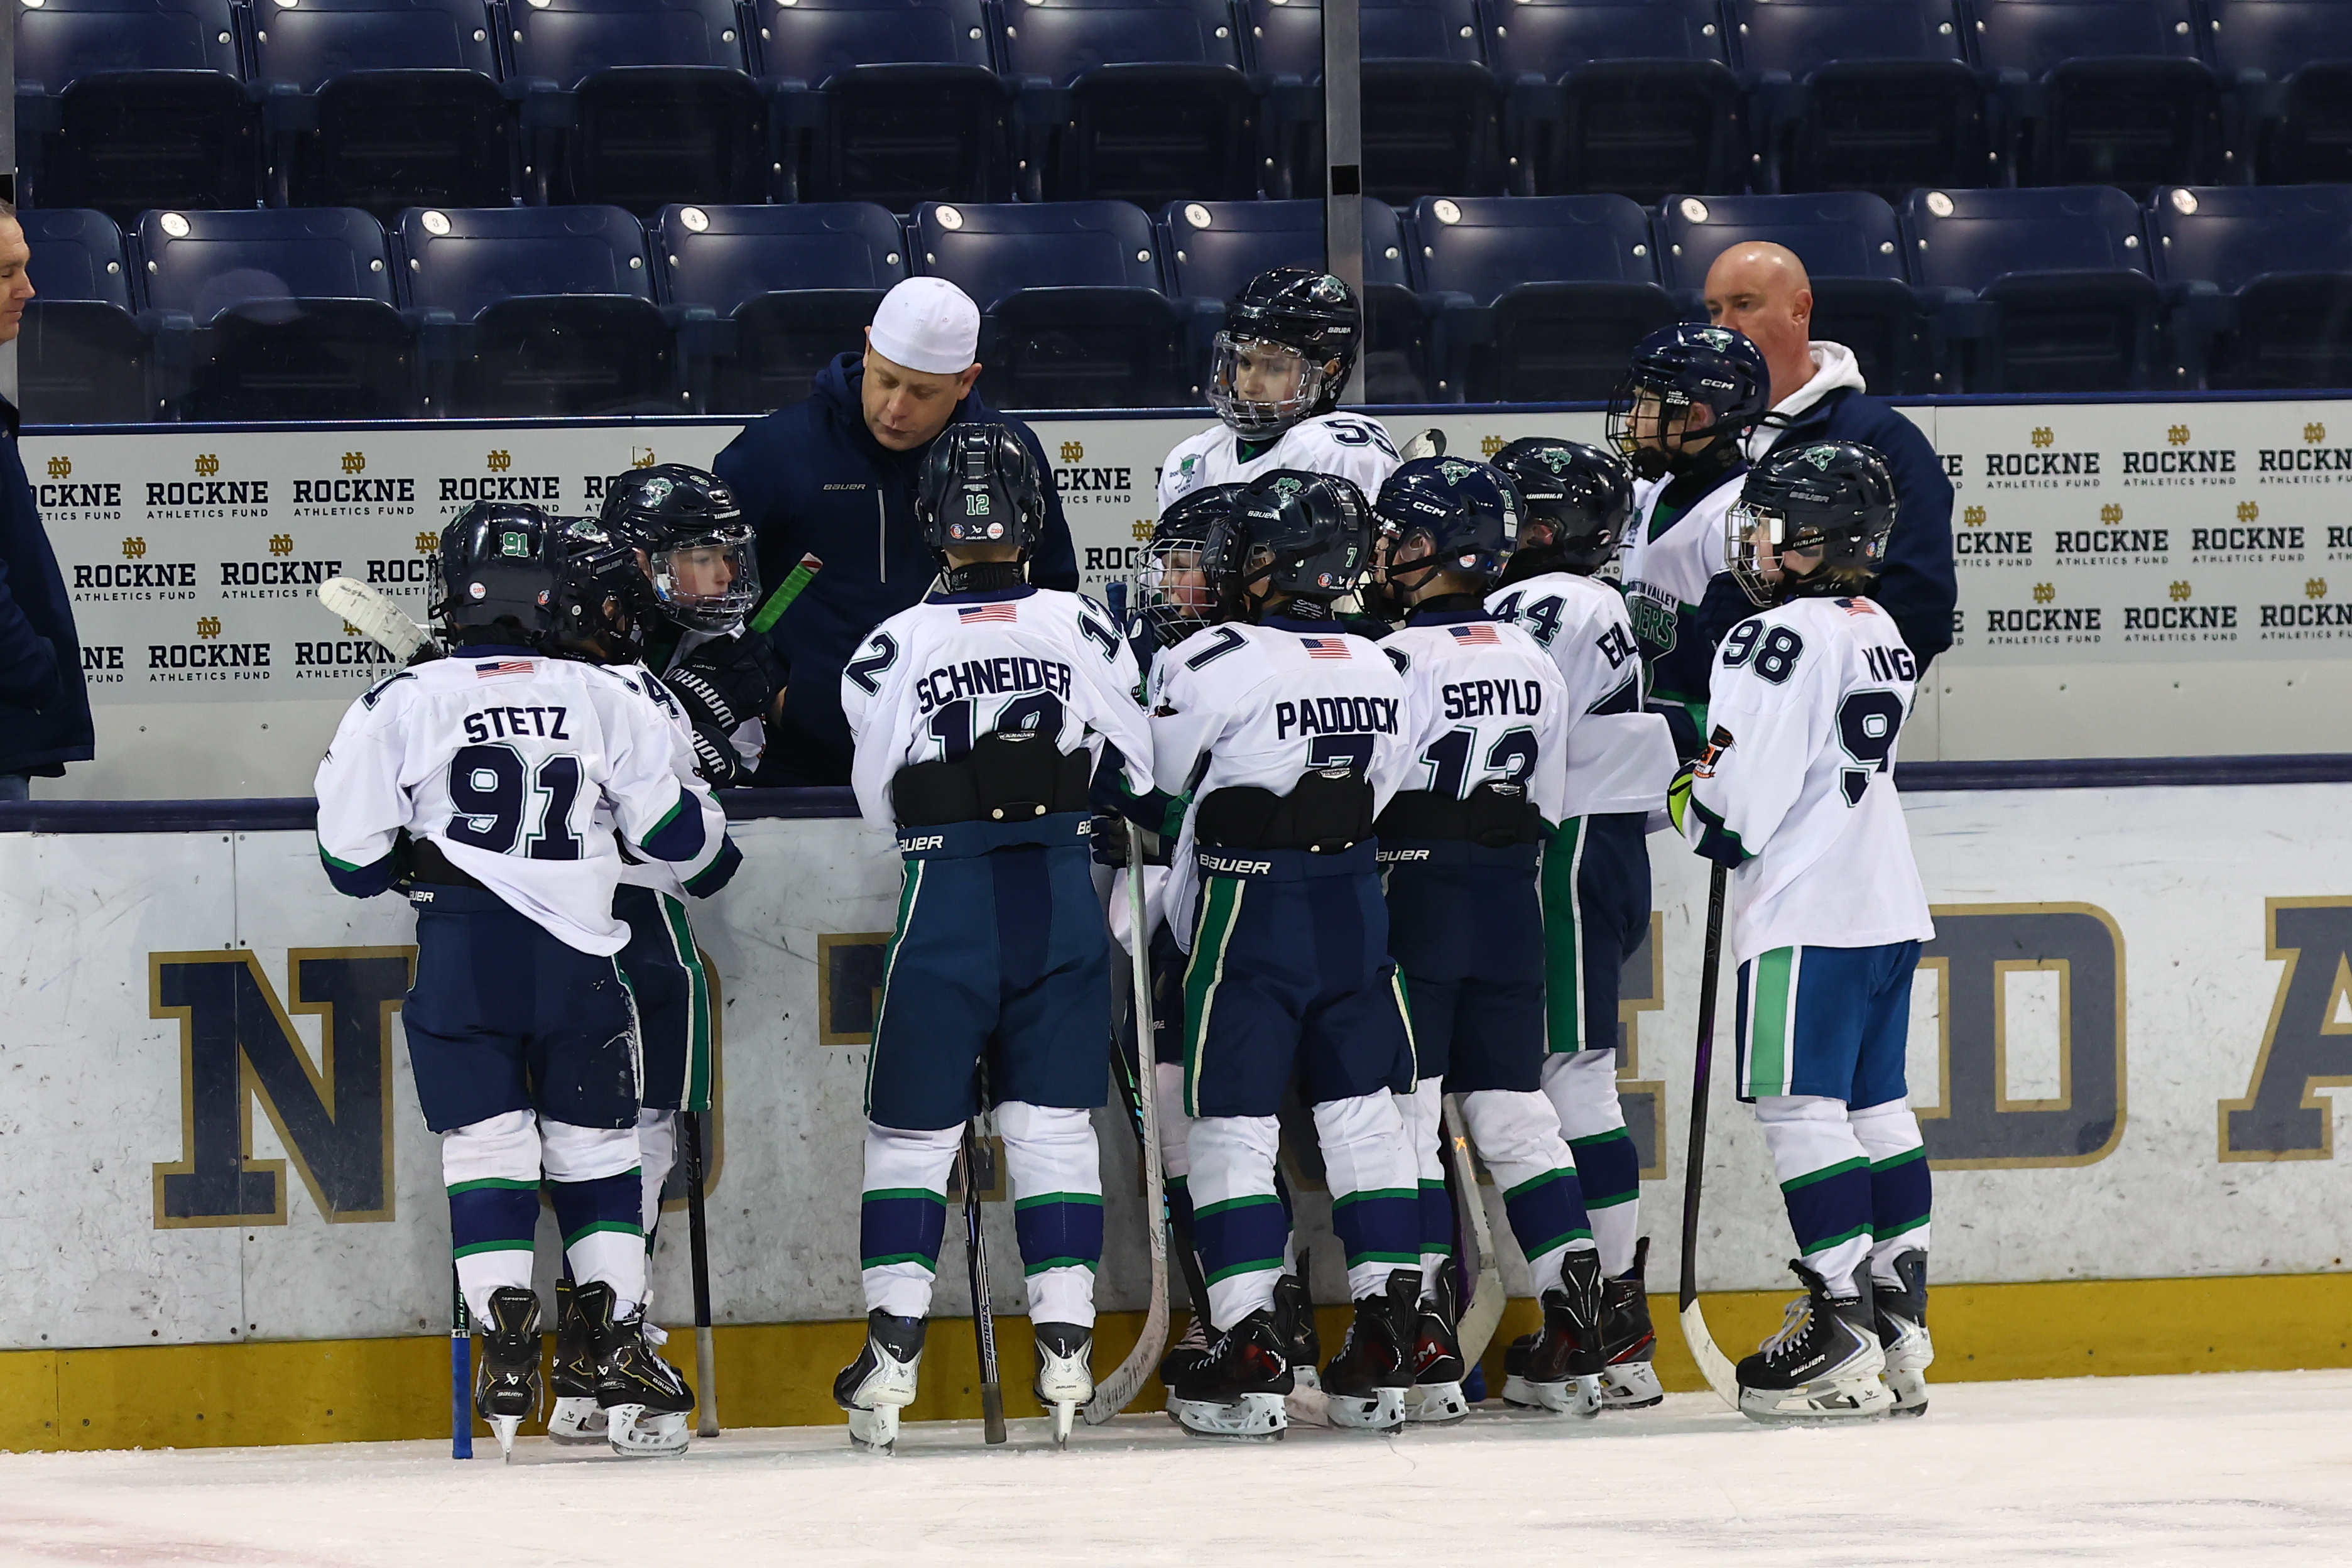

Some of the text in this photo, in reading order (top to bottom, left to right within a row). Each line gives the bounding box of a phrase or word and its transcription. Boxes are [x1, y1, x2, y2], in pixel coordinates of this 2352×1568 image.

[1701, 378, 1734, 390] CCM
[1666, 398, 1690, 406] CCM
[1986, 452, 2100, 476] ROCKNE
[2123, 450, 2236, 474] ROCKNE
[2258, 449, 2352, 471] ROCKN
[439, 476, 559, 501] ROCKNE
[823, 483, 866, 491] BAUER
[1054, 467, 1131, 491] CKNE
[1988, 480, 2058, 489] ATHLETICS
[2125, 477, 2194, 486] ATHLETICS
[2260, 476, 2330, 484] ATHLETICS
[146, 481, 268, 506] ROCKNE
[293, 479, 414, 503] ROCKNE
[1096, 495, 1130, 503] FUND
[147, 508, 268, 519] ATHLETICS FUND
[294, 506, 414, 516] ATHLETICS FUND
[966, 494, 989, 515] 12
[1412, 501, 1447, 517] CCM
[85, 511, 121, 520] FUND
[503, 532, 528, 558] 91
[1957, 531, 2032, 555] CKNE
[2055, 530, 2169, 553] ROCKNE
[2192, 526, 2305, 550] ROCKNE
[1345, 547, 1358, 568] 7
[1999, 558, 2032, 567] FUND
[2057, 557, 2127, 566] ATHLETICS
[2193, 553, 2305, 564] ATHLETICS FUND
[74, 564, 195, 588] ROCKNE
[75, 592, 195, 602] ATHLETICS FUND
[222, 589, 298, 599] ATHLETICS
[1988, 608, 2101, 632] ROCKNE
[2124, 606, 2238, 629] ROCKNE
[2260, 604, 2352, 628] ROCKN
[1988, 634, 2101, 645] ATHLETICS FUND
[2125, 633, 2237, 642] ATHLETICS FUND
[2262, 631, 2331, 640] ATHLETICS
[148, 643, 270, 668] ROCKNE
[1185, 625, 1250, 671] 7
[1721, 618, 1805, 685] 98
[87, 673, 123, 683] FUND
[150, 671, 270, 682] ATHLETICS FUND
[296, 669, 371, 679] ATHLETICS
[917, 657, 1071, 714] SCHNEIDER
[1443, 679, 1541, 720] SERYLO
[463, 707, 570, 743] STETZ
[1276, 697, 1400, 741] PADDOCK
[445, 742, 585, 859] 91
[1199, 854, 1271, 875] BAUER
[982, 1314, 993, 1361] BAUER
[1790, 1354, 1826, 1377] BAUER
[653, 1378, 677, 1396] BAUER
